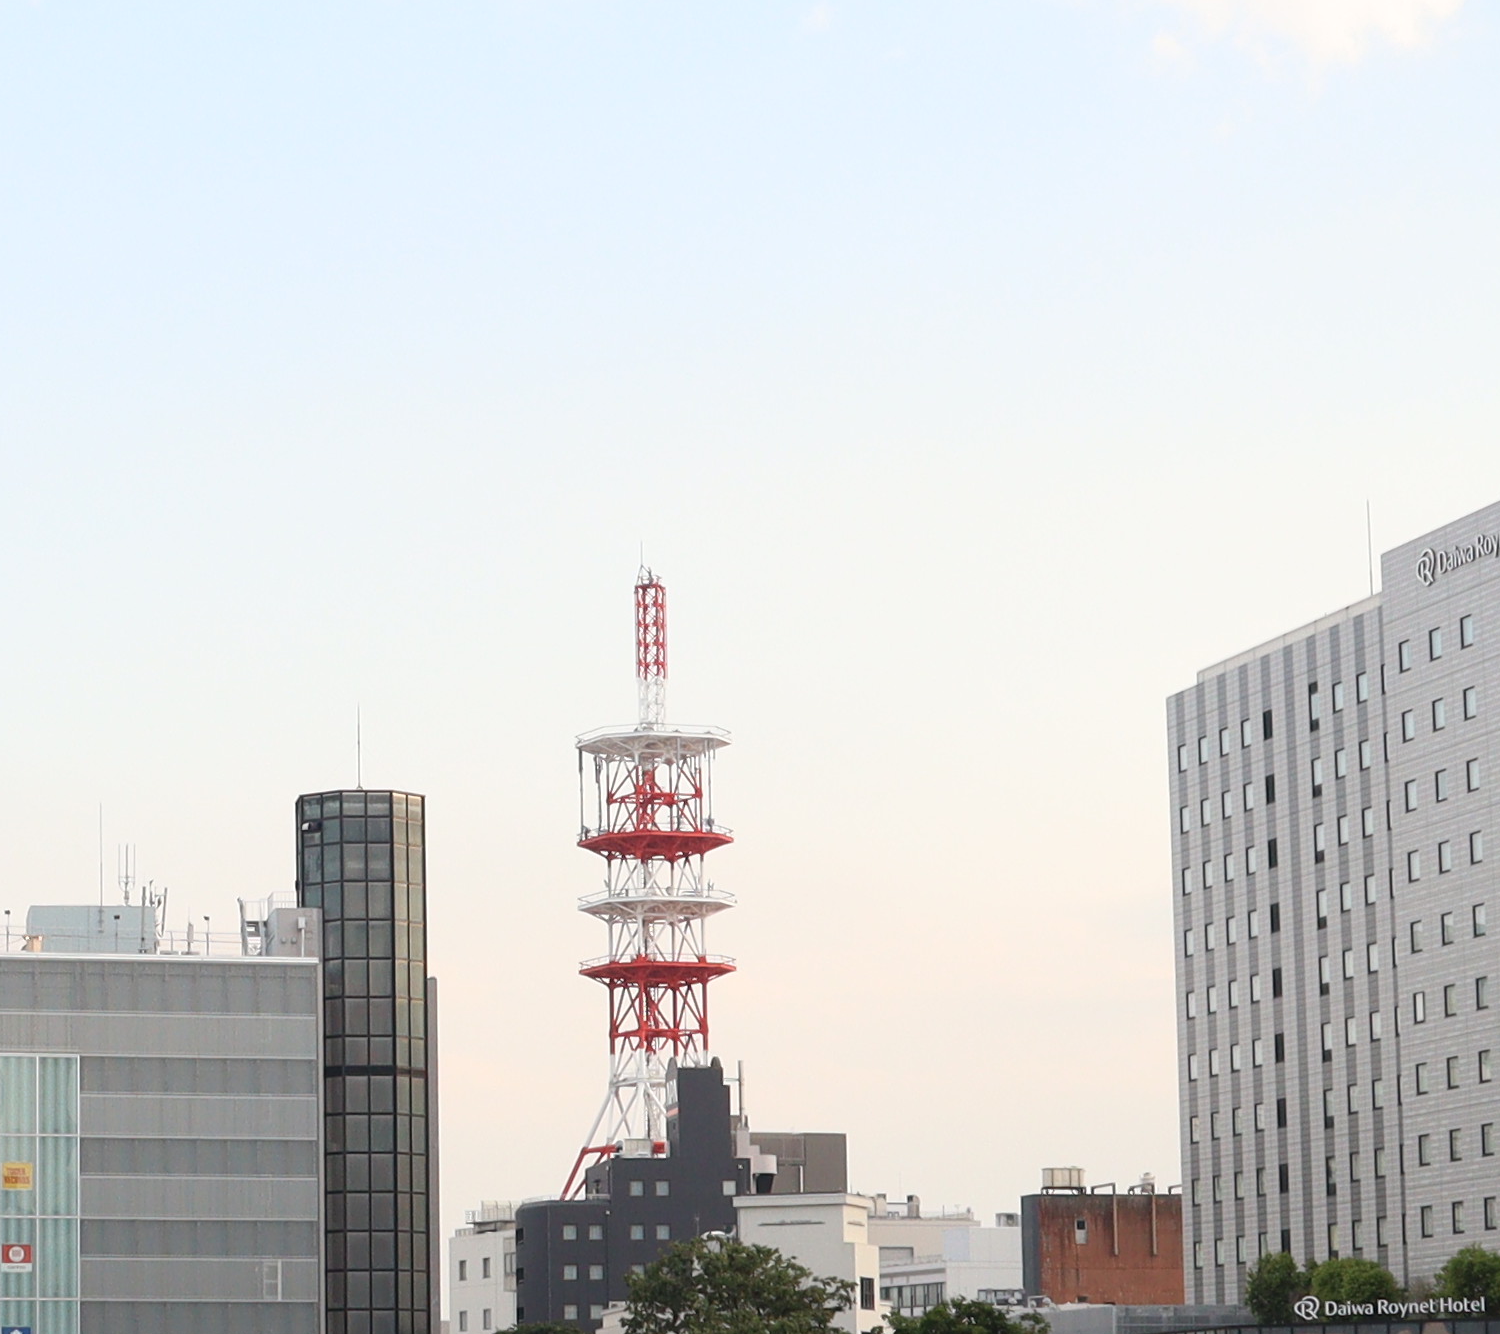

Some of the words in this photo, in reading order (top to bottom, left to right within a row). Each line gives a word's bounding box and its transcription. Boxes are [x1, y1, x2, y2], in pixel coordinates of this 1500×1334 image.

[1437, 541, 1475, 574] Daiwa
[1324, 1299, 1374, 1316] Daiwa
[1377, 1297, 1435, 1318] Roynet
[1439, 1296, 1487, 1313] Hotel
